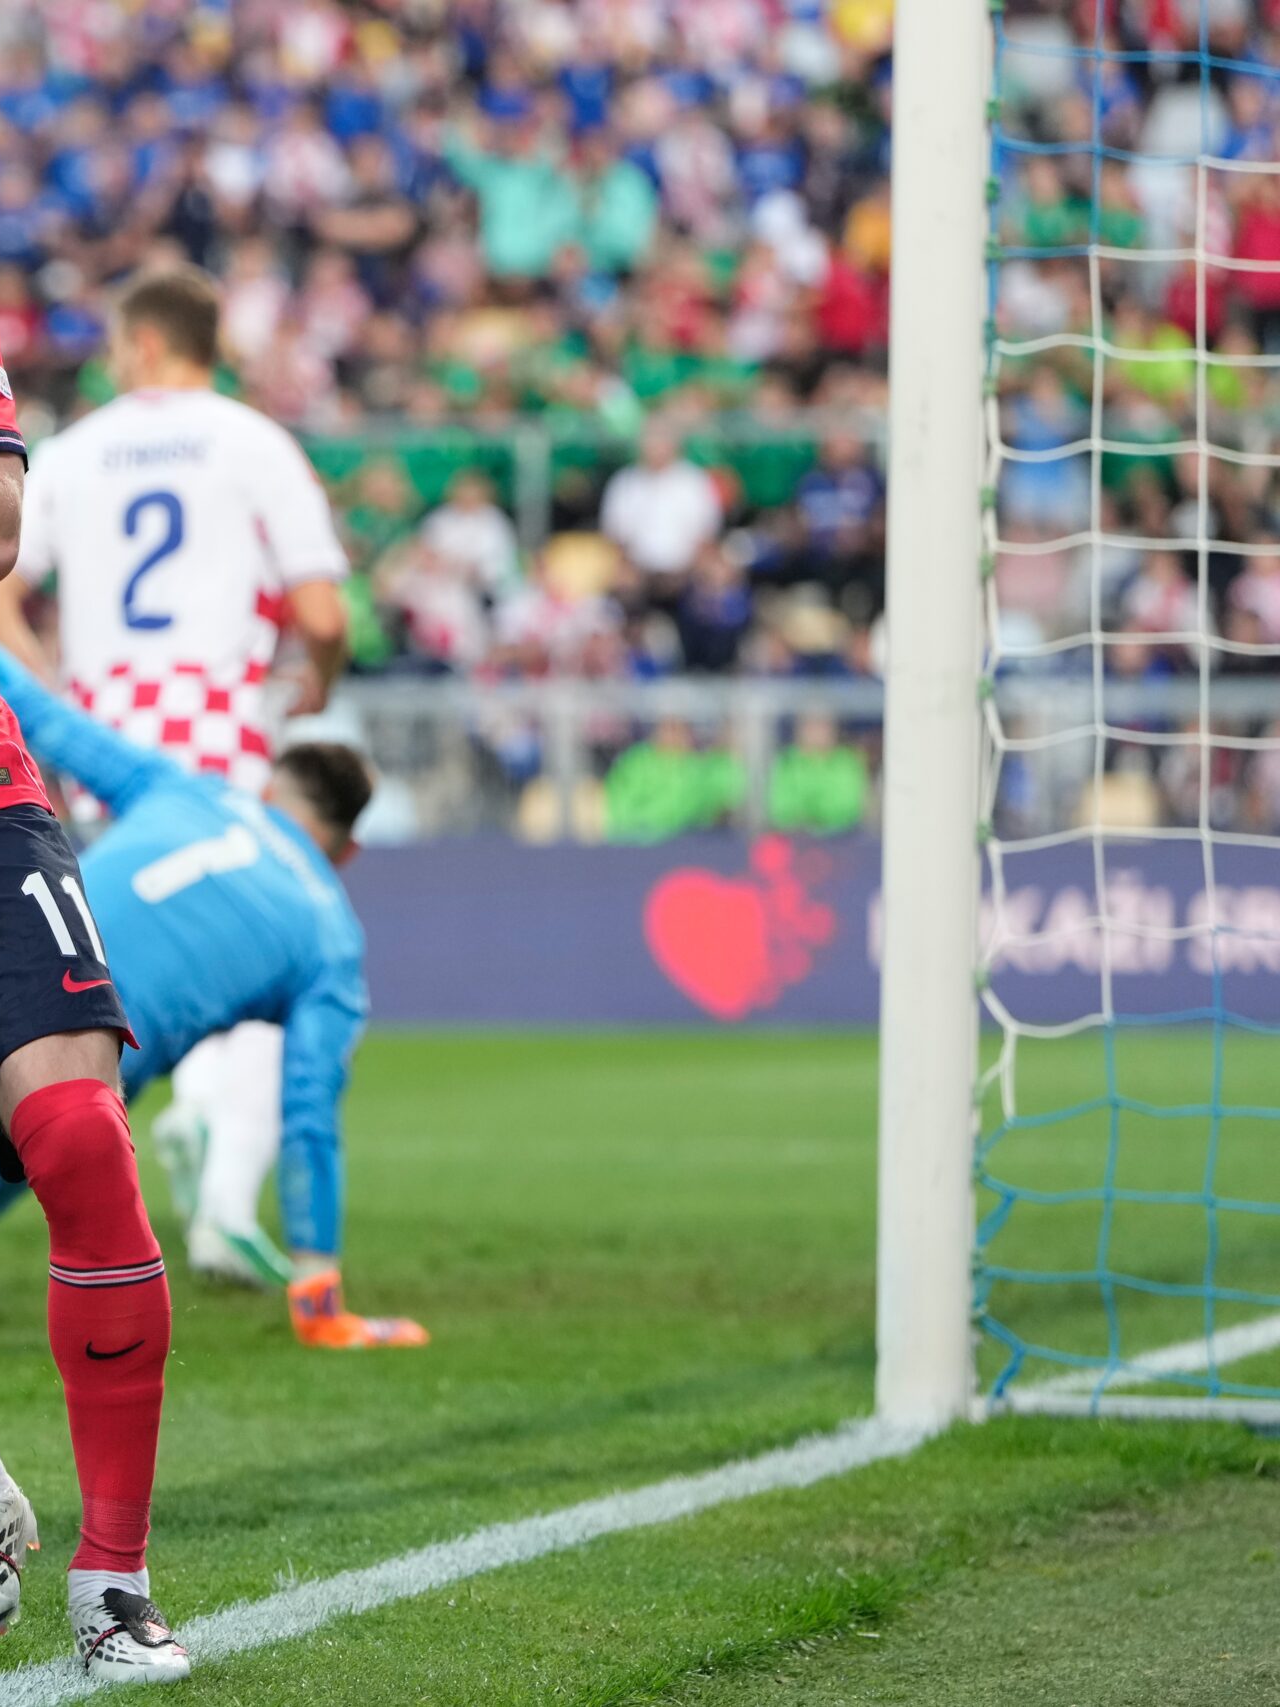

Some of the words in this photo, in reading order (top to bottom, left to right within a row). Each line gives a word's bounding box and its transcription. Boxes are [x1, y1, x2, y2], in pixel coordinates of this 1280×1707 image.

[124, 490, 183, 629] 2
[132, 825, 259, 903] 1
[20, 870, 107, 967] 11
